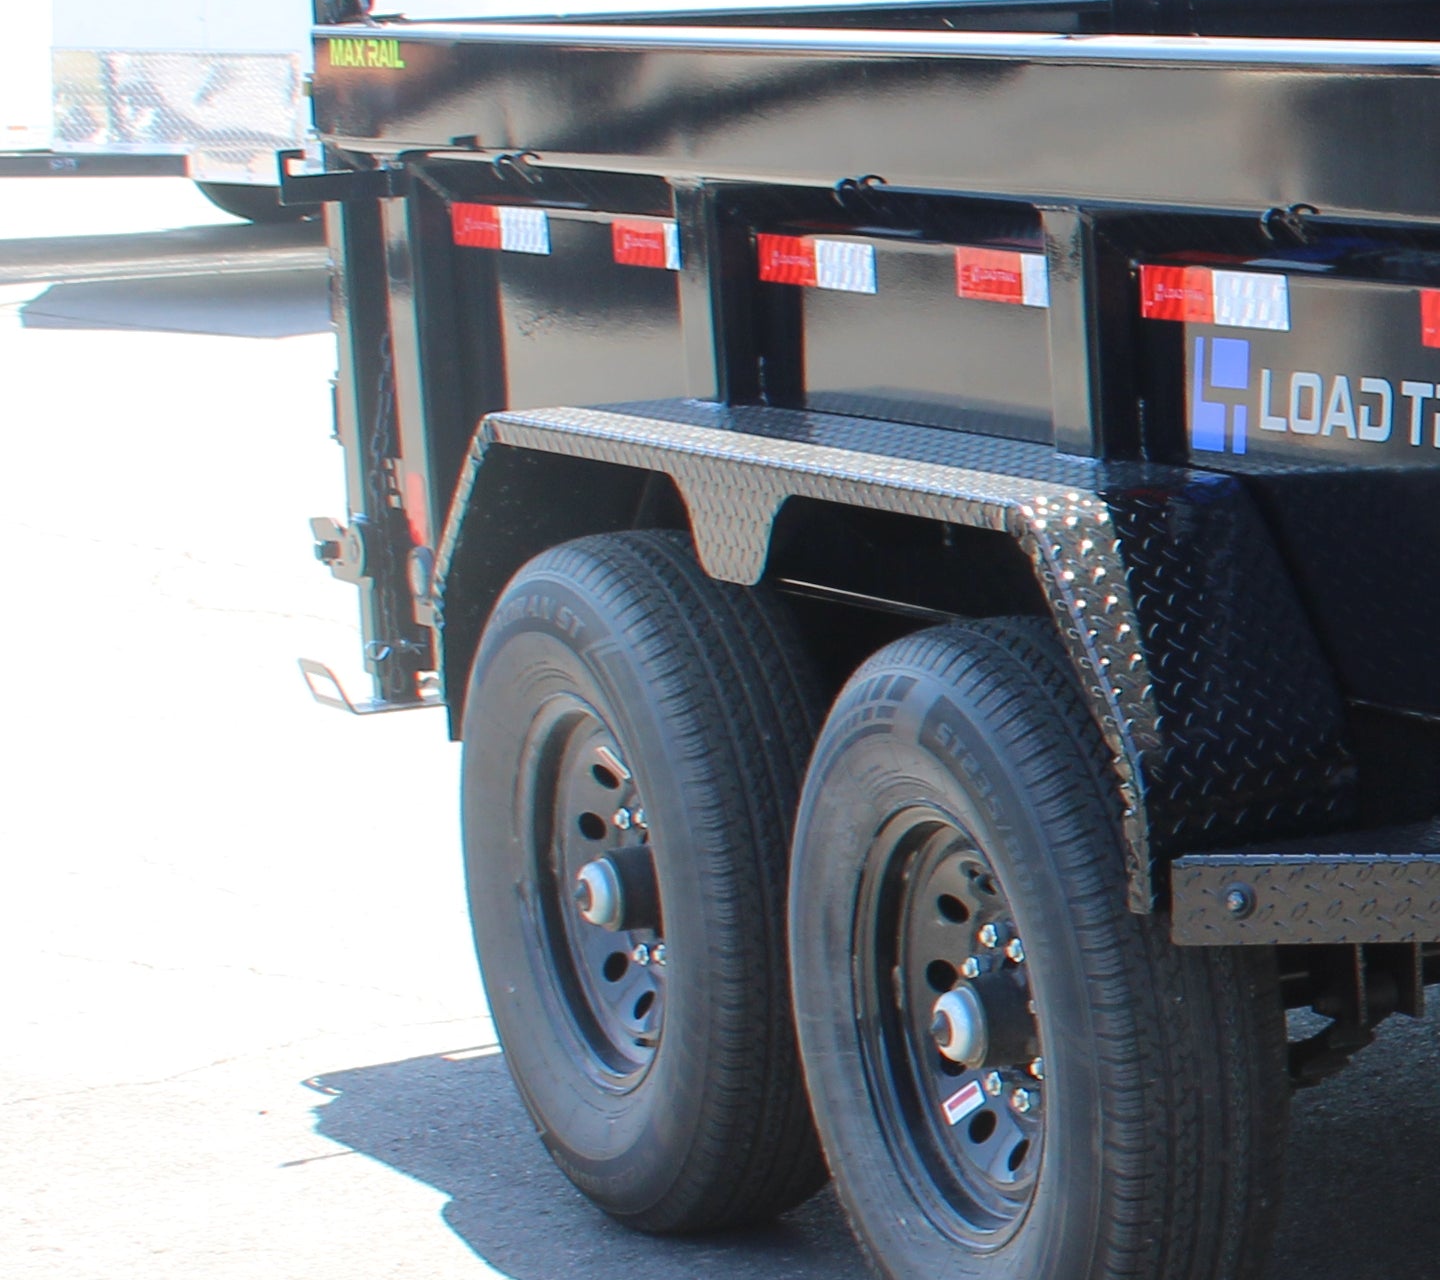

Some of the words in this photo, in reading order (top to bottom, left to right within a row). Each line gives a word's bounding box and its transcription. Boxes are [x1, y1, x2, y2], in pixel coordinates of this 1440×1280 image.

[329, 38, 366, 67] MAX
[367, 39, 406, 68] RAIL
[1258, 367, 1393, 444] LOAD
